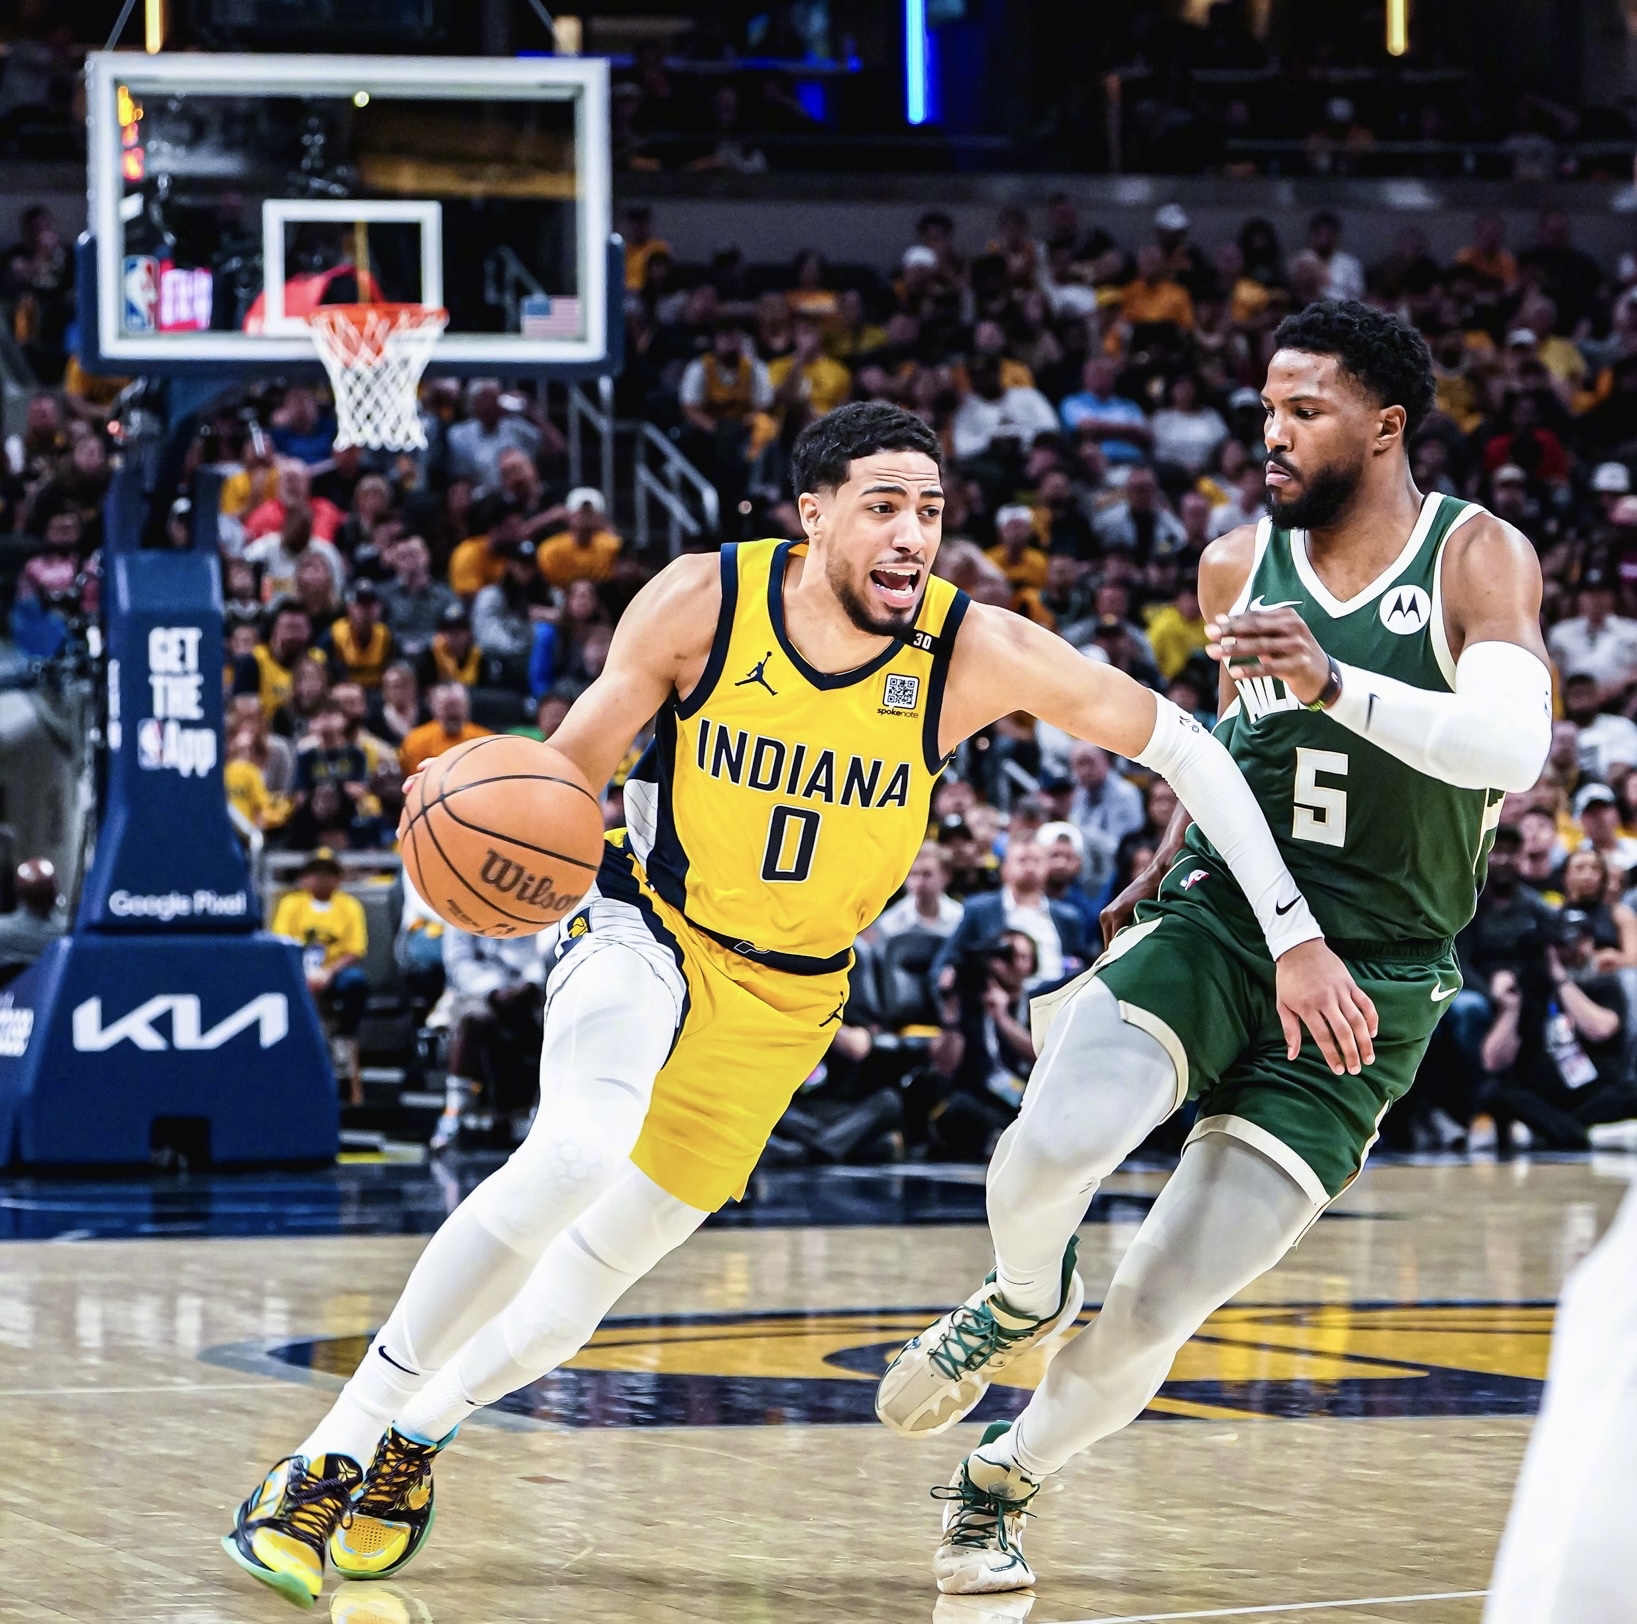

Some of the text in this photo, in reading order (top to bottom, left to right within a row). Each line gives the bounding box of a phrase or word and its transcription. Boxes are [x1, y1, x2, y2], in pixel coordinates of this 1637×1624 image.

[148, 627, 203, 672] GET
[913, 633, 932, 650] 30
[148, 673, 204, 720] THE
[877, 707, 919, 719] spokenote
[697, 716, 911, 809] INDIANA
[1292, 747, 1348, 848] 5
[760, 803, 823, 884] 0
[109, 889, 247, 922] Google Pixel
[72, 992, 289, 1052] KIA
